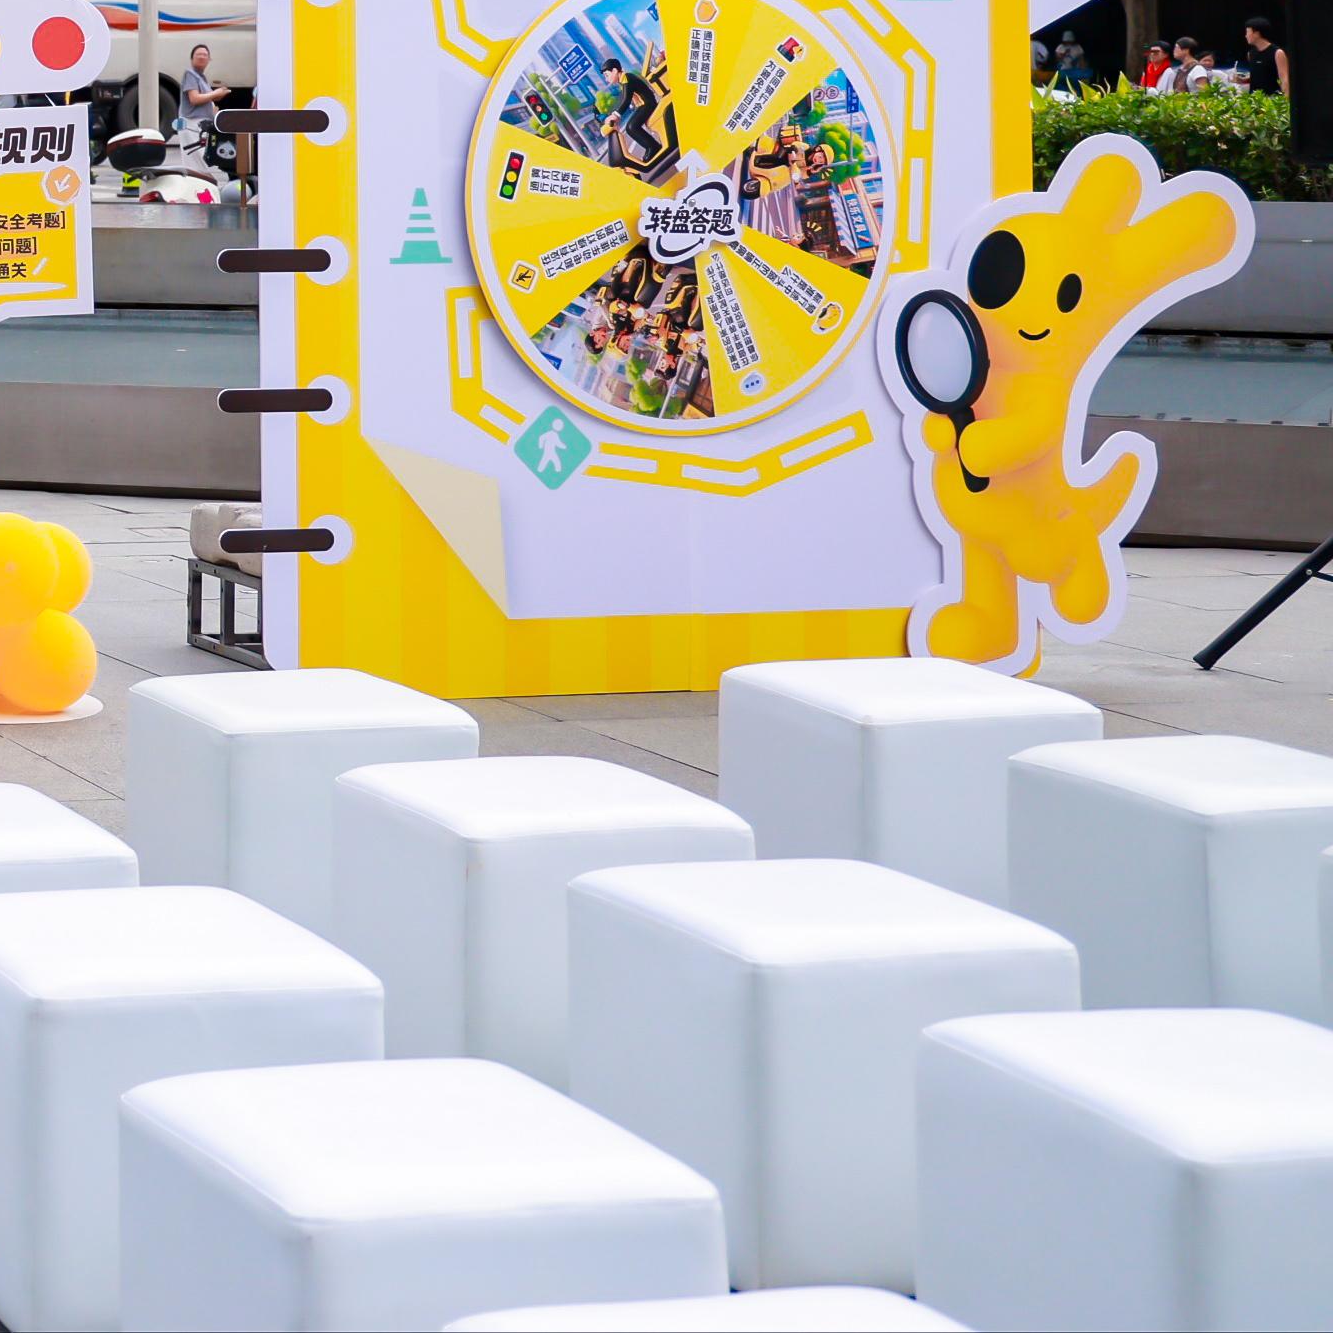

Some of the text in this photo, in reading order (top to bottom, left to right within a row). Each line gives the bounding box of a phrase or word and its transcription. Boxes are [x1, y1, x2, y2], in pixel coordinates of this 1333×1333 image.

[531, 167, 581, 184] 黄灯闪烁时
[529, 181, 579, 196] 通行方式是
[645, 206, 736, 236] 转盘答题
